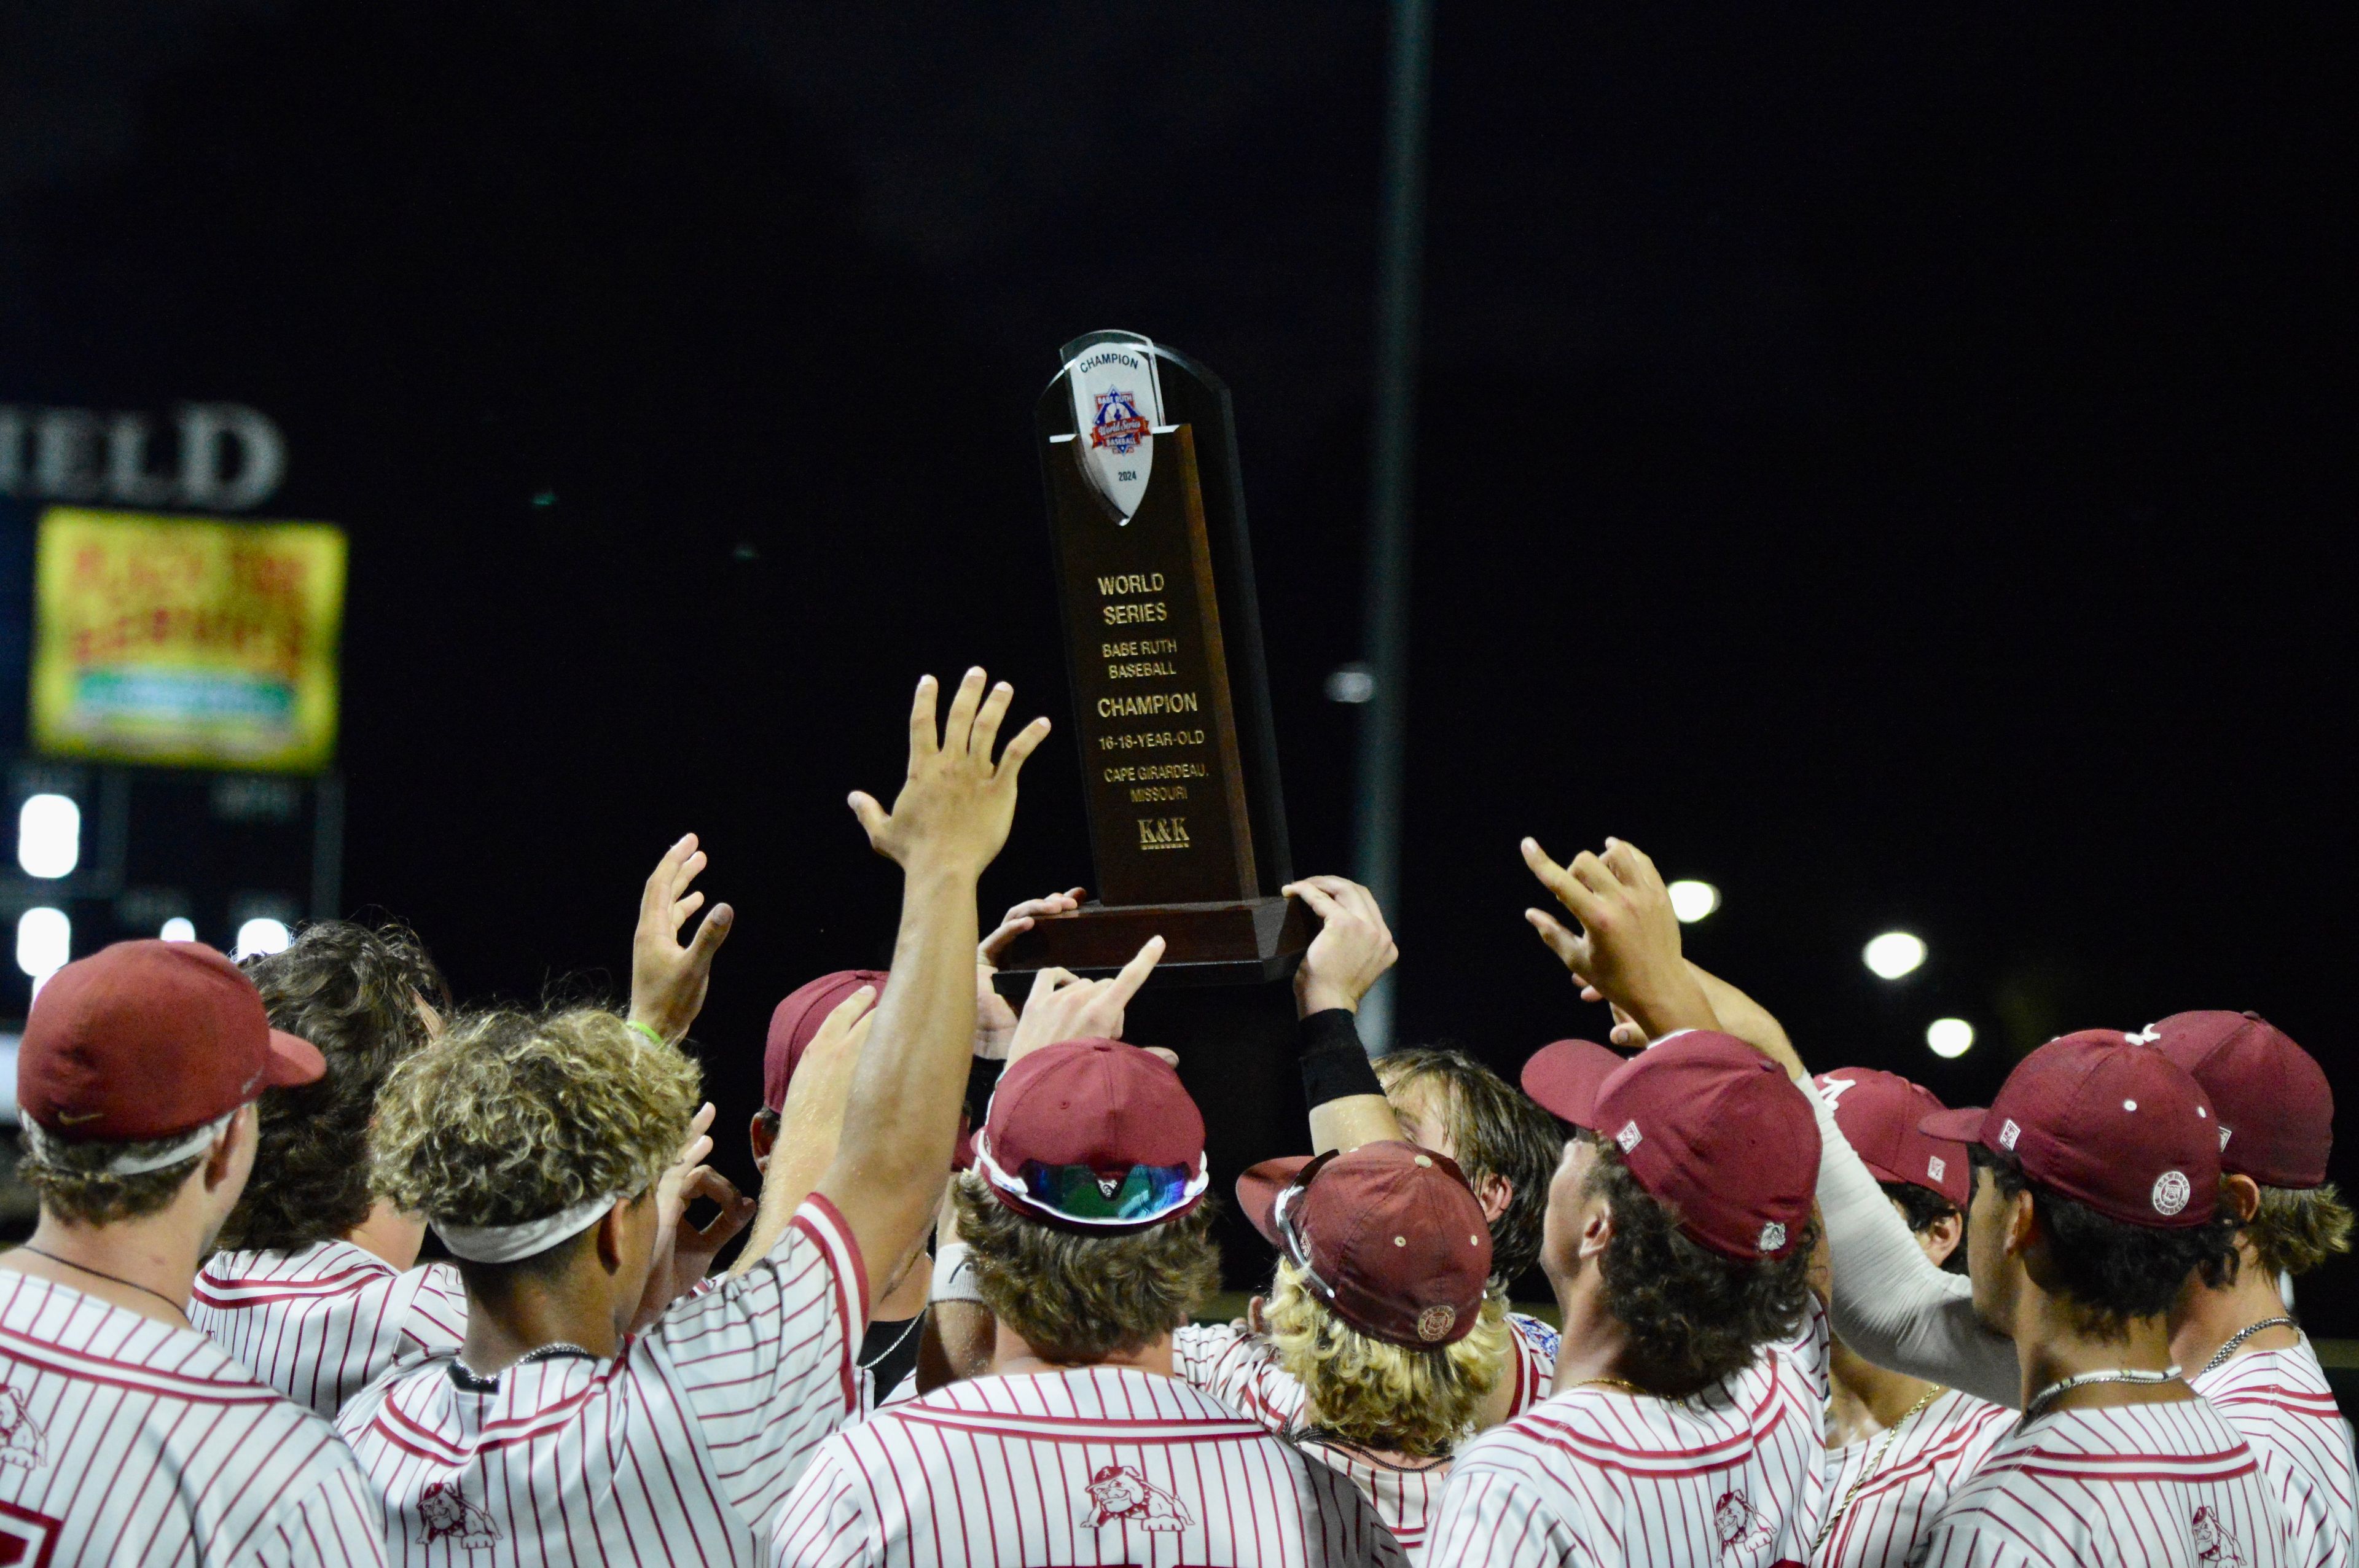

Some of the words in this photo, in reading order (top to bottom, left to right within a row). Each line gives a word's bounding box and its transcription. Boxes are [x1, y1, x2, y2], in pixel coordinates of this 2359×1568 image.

[1079, 353, 1139, 373] CHAMPION
[1098, 421, 1120, 436] World
[1121, 419, 1141, 431] Series
[1106, 437, 1136, 447] BASEBALL
[1118, 470, 1137, 482] 2024
[1097, 572, 1165, 596] WORLD
[1103, 602, 1168, 625] SERIES
[1101, 641, 1138, 658] BABE
[1140, 638, 1178, 655] RUTH
[1108, 661, 1177, 679] BASEBALL
[1097, 692, 1198, 718] CHAMPION
[1098, 730, 1205, 751] 16-18-YEAR-OLD
[1103, 766, 1136, 782] CAPE
[1129, 786, 1188, 803] MISSOURI
[1136, 817, 1191, 843] K&K
